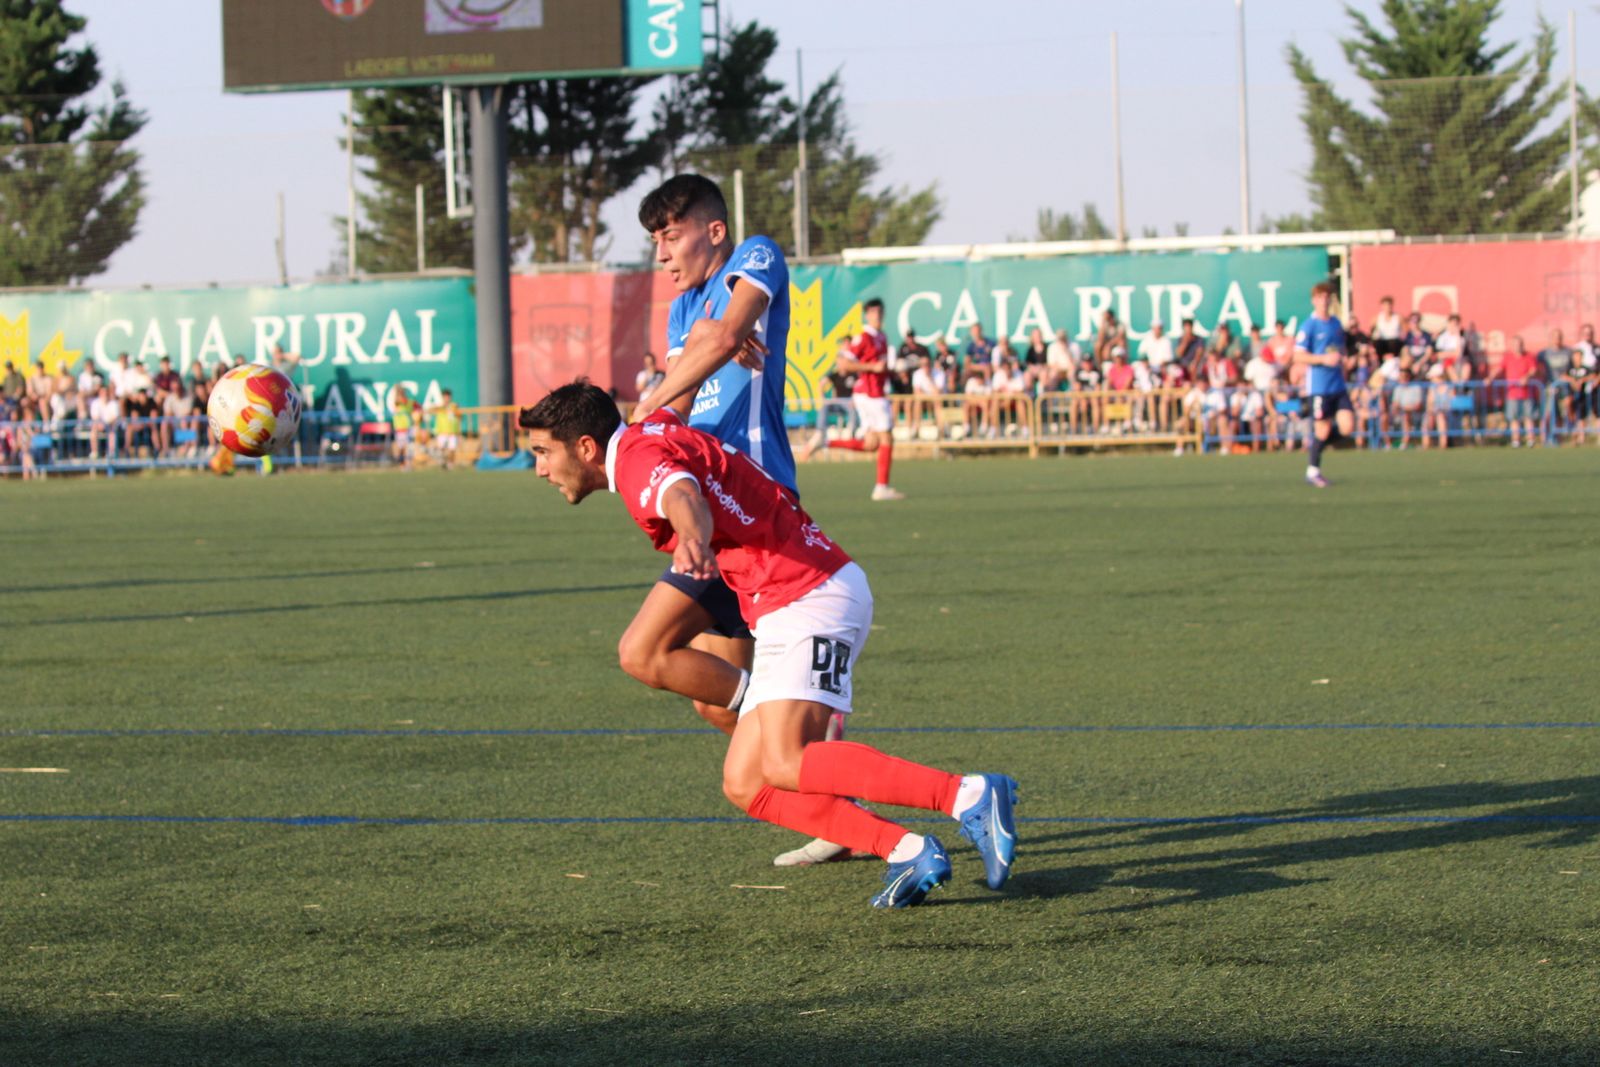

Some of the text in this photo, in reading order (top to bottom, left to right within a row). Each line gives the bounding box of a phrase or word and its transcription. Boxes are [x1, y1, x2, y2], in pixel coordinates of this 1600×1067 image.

[94, 308, 451, 378] CAJA RURAL
[896, 280, 1298, 345] CAJA RURAL
